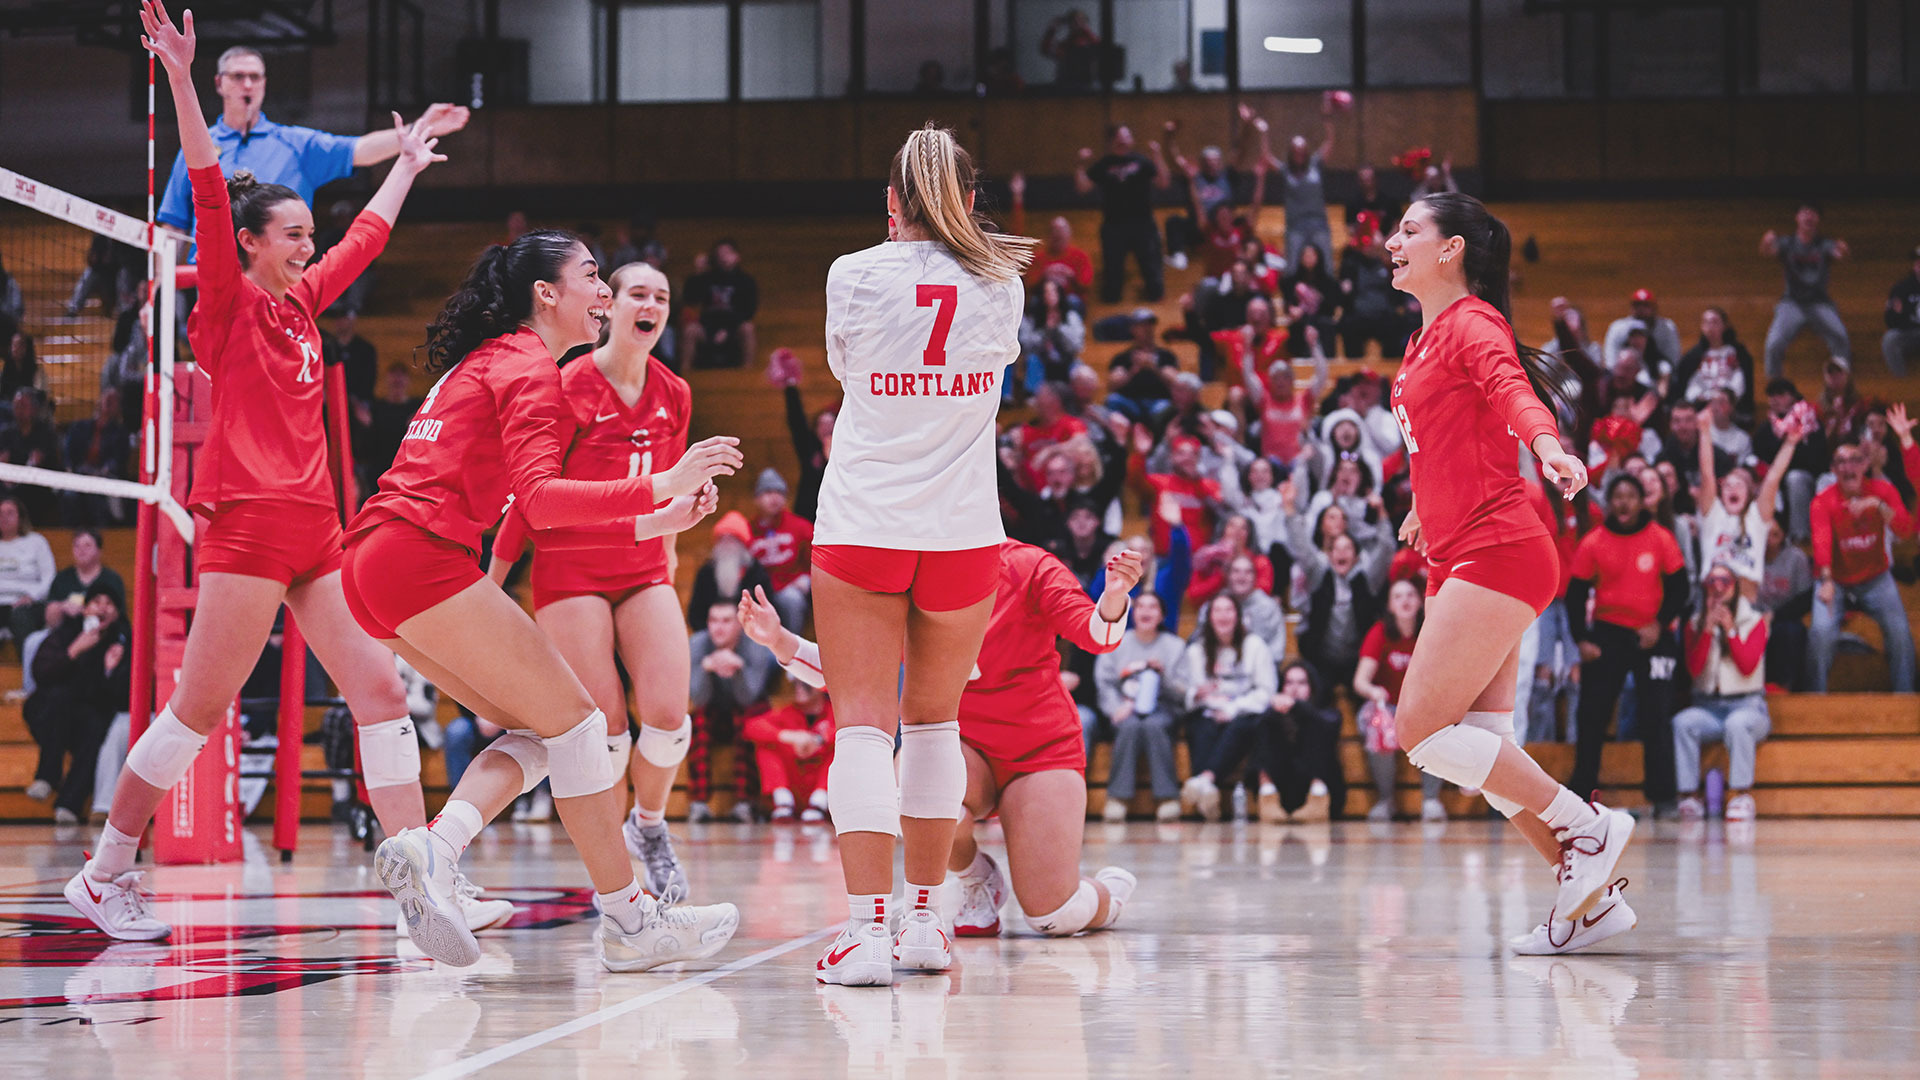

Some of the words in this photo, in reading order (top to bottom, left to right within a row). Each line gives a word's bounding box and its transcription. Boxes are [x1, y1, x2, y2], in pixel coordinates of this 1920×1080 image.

[915, 284, 958, 366] 7
[870, 371, 995, 397] CORTLAND
[1392, 404, 1420, 454] 12
[627, 451, 653, 479] 11
